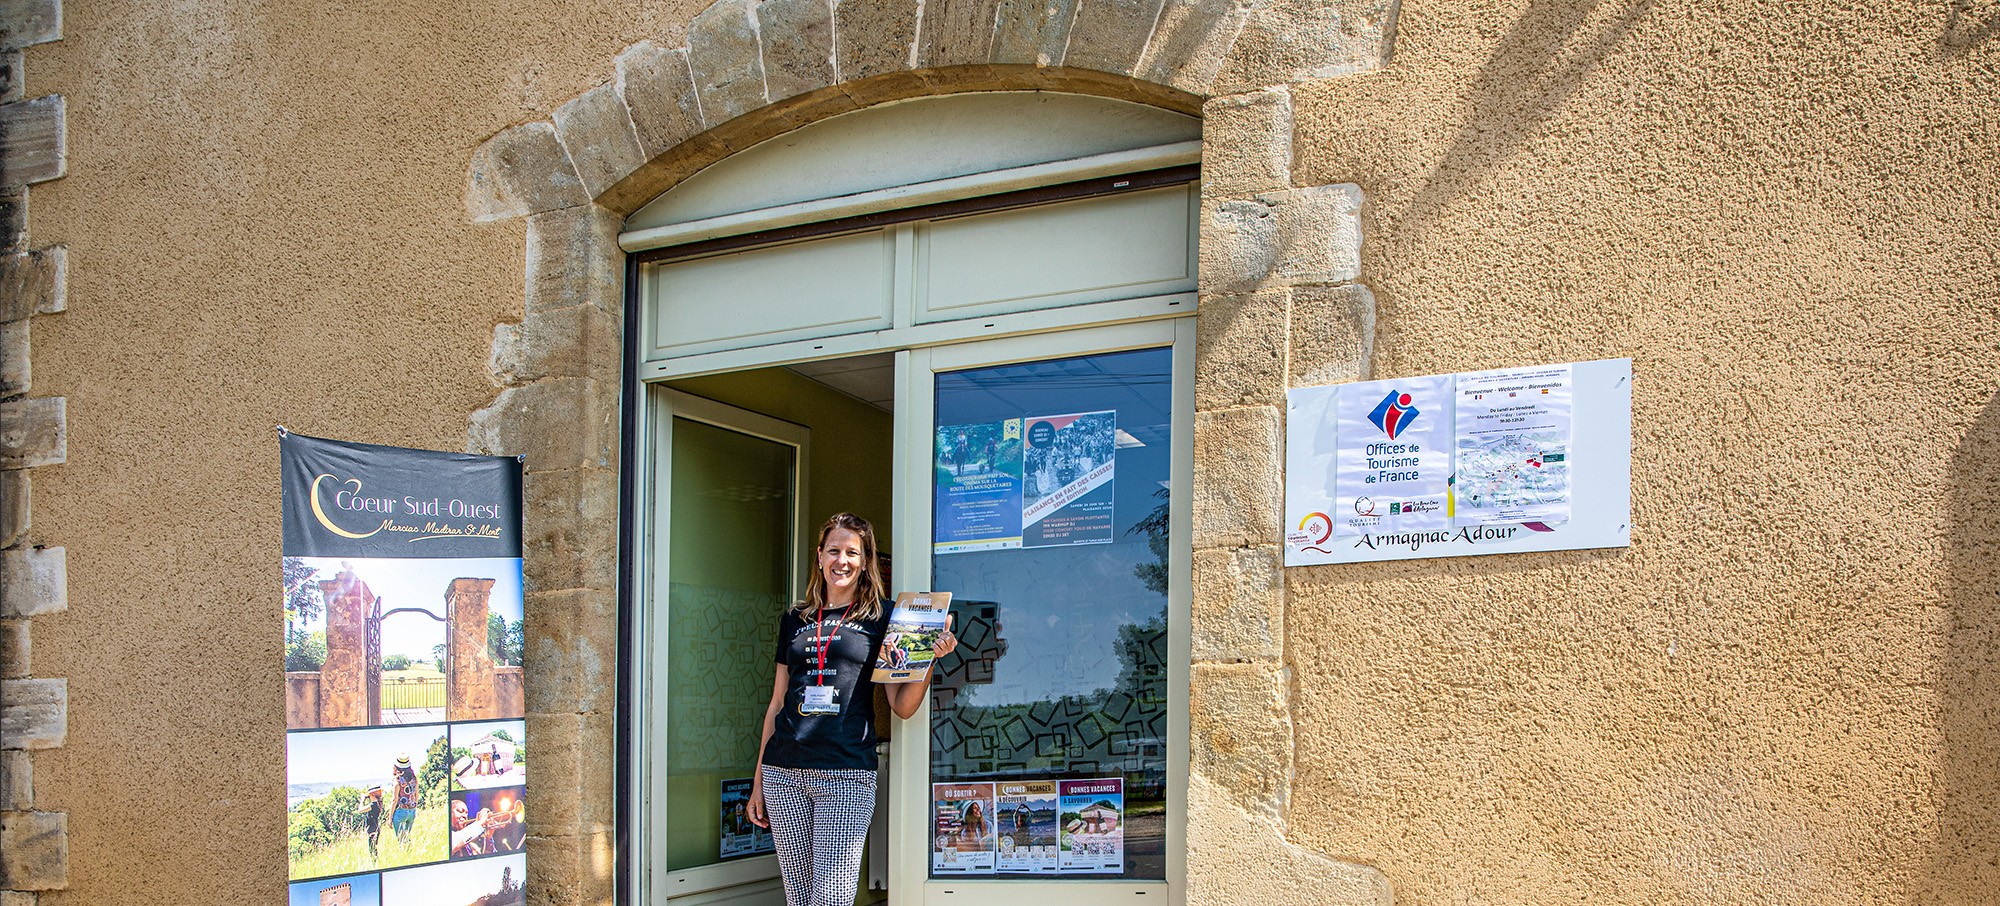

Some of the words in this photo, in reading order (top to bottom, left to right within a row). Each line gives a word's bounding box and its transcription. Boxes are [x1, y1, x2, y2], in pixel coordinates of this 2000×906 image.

[1366, 443, 1405, 456] Offices
[1409, 444, 1420, 453] de
[1366, 456, 1419, 469] Tourisme
[1365, 475, 1376, 484] de
[1379, 470, 1419, 483] France
[1023, 499, 1055, 518] PLAISANCE
[1055, 493, 1063, 501] EN
[1063, 484, 1076, 496] FAIT
[1077, 478, 1089, 487] DES
[1089, 464, 1113, 480] CAISSES
[335, 489, 397, 514] Coeur
[403, 495, 501, 519] Sud-Ouest
[380, 519, 419, 534] Marciac
[421, 521, 462, 535] Madiran
[476, 523, 502, 537] Mont
[1354, 530, 1450, 551] Armagnac
[1451, 525, 1517, 545] Adour
[908, 604, 933, 612] VACANCES
[811, 668, 837, 676] Aniations
[944, 788, 953, 798] OÙ
[954, 789, 973, 798] SORTIR
[1006, 785, 1025, 793] BONNES
[1026, 784, 1051, 792] VACANCES
[1070, 786, 1090, 794] BONNES
[1090, 785, 1116, 793] VACANCES
[1068, 796, 1092, 804] SAVOURER
